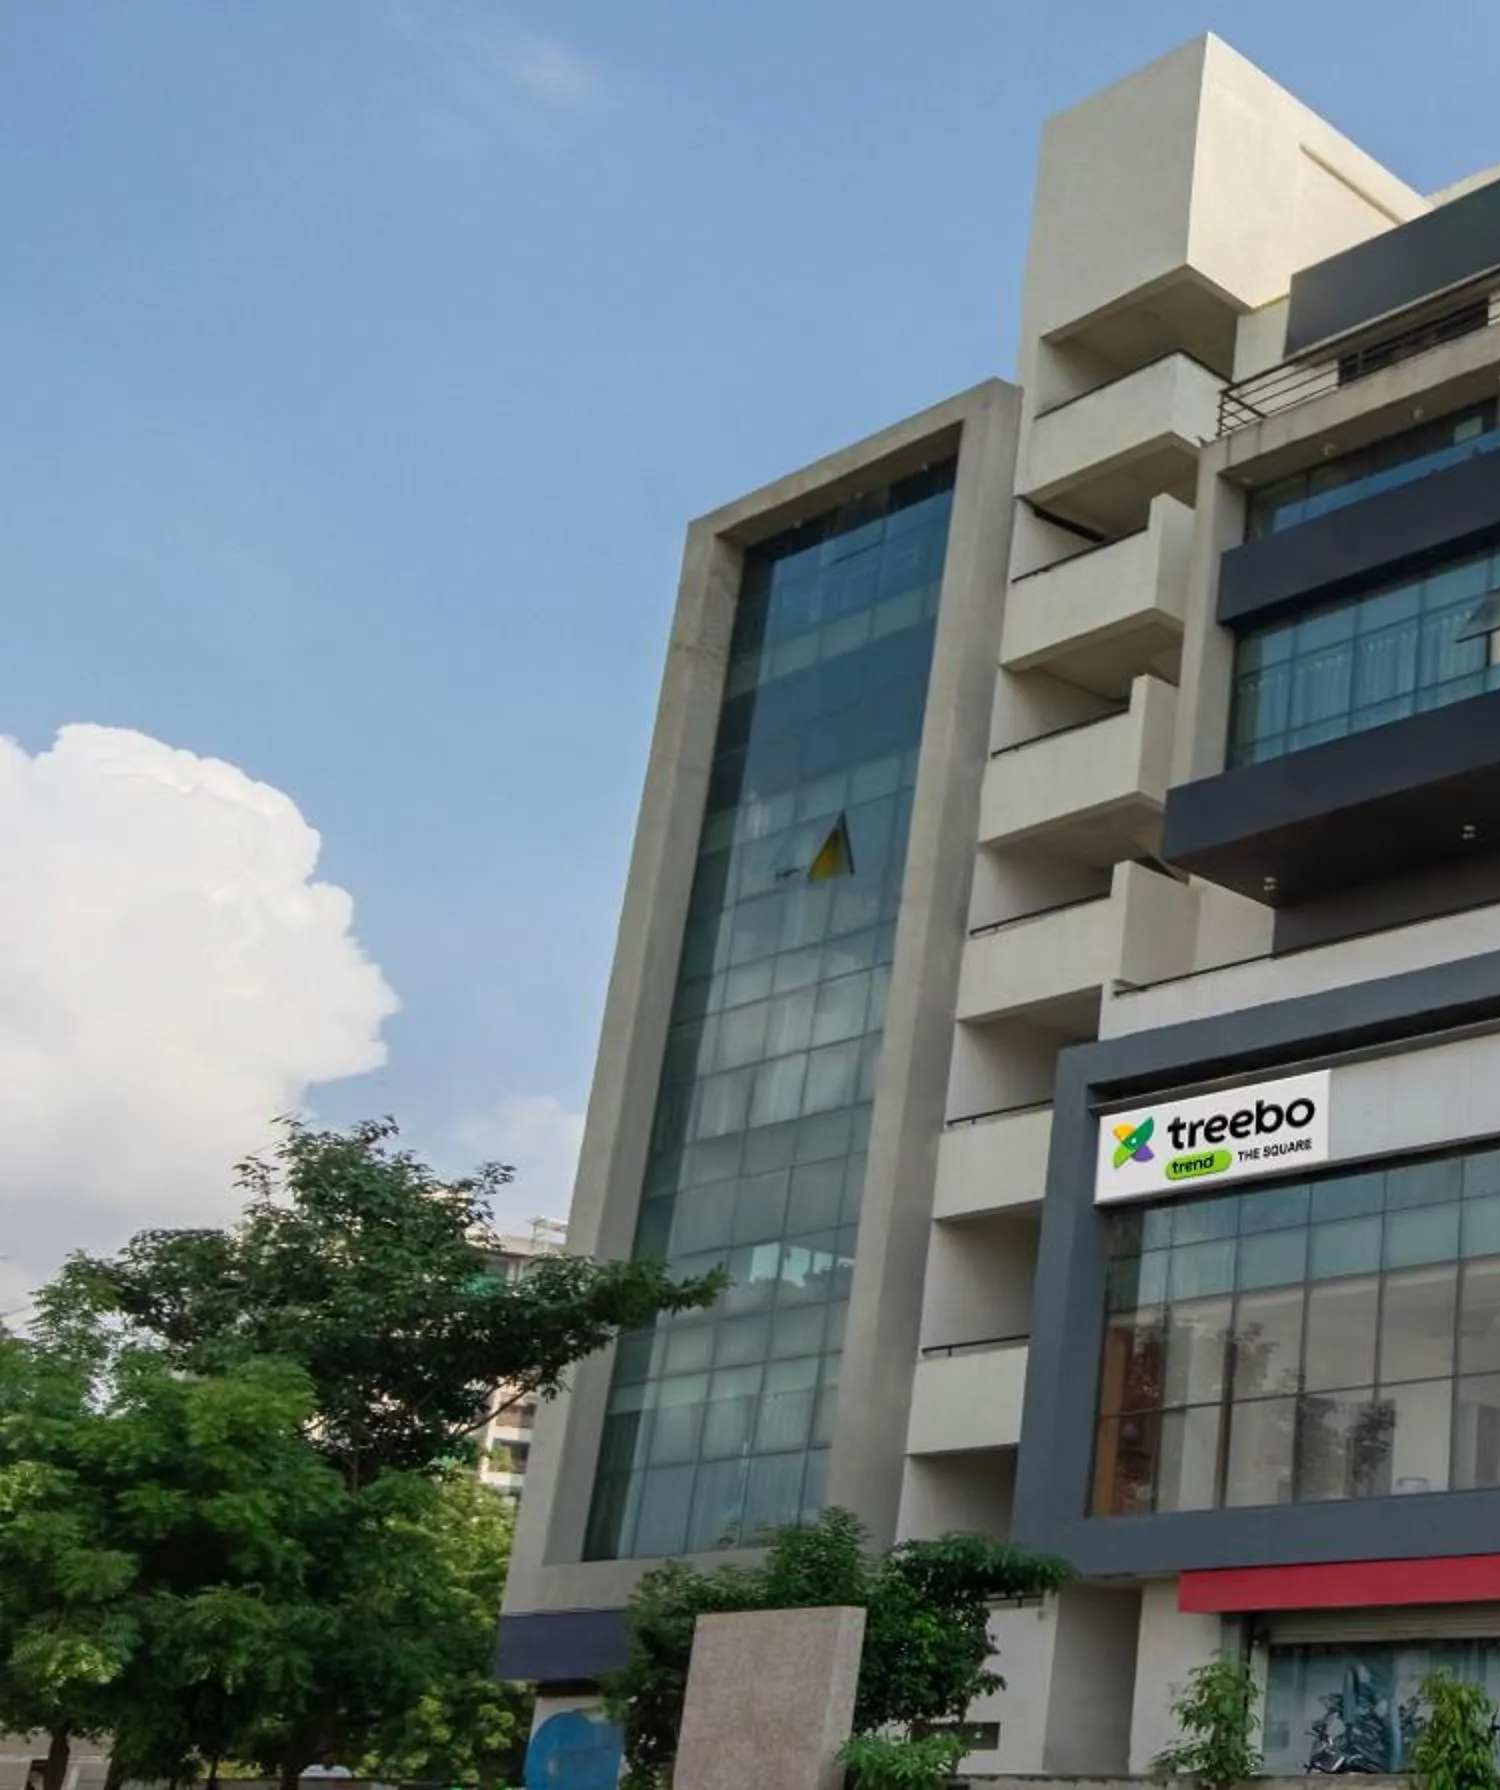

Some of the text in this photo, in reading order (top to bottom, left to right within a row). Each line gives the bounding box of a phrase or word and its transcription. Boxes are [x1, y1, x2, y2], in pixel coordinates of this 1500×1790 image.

[1167, 1098, 1315, 1149] treebo
[1238, 1138, 1313, 1162] THE SQUARE
[1172, 1155, 1215, 1175] trend
